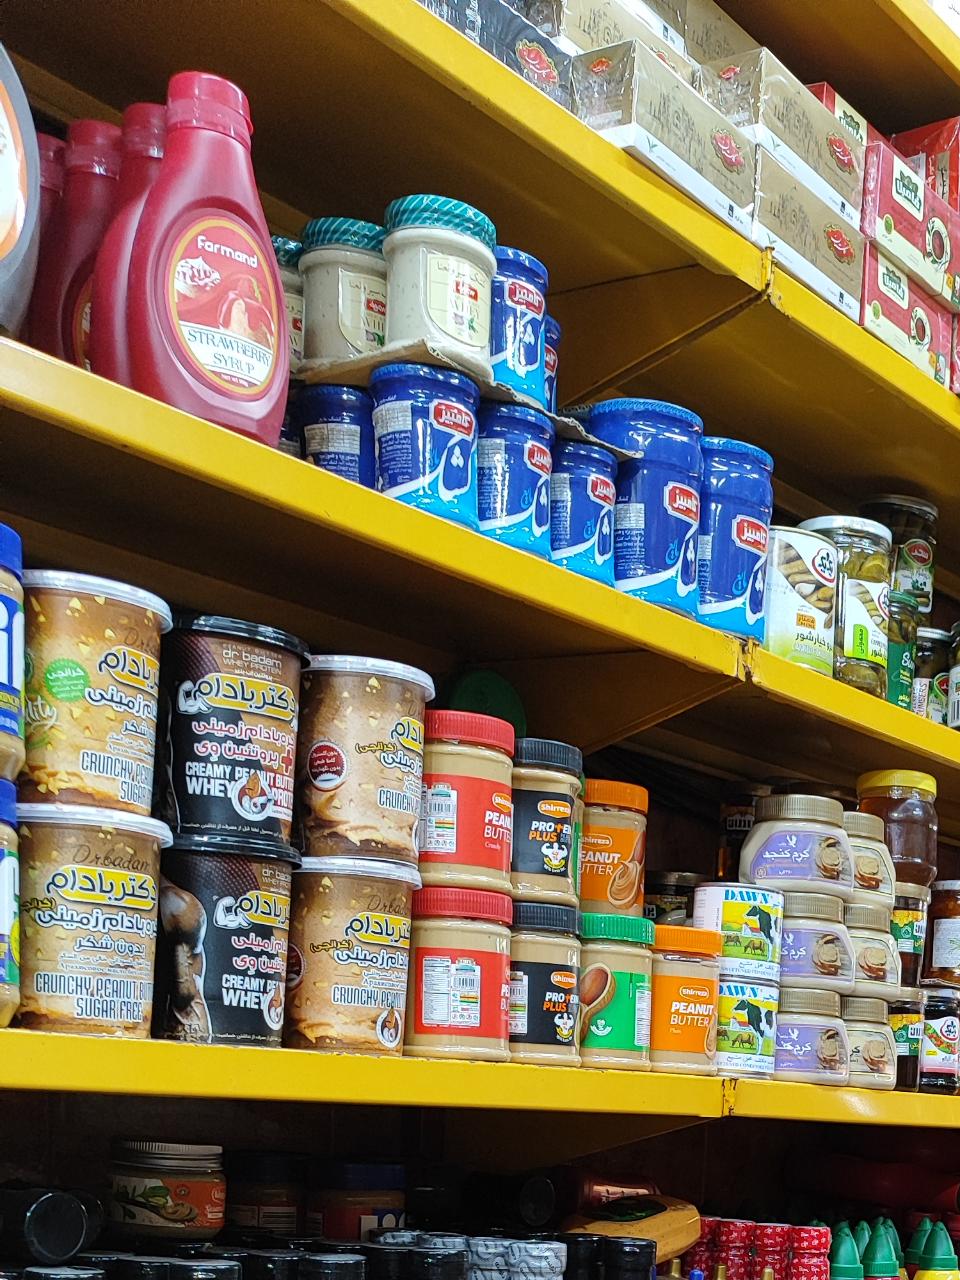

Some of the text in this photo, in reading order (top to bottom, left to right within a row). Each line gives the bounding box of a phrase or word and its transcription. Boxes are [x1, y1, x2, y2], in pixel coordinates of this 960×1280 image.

[197, 235, 258, 269] Farmand
[187, 329, 271, 368] STRAWBERRY
[213, 353, 255, 375] SYRUP
[222, 648, 282, 669] dr badam
[222, 657, 249, 668] WHEY
[81, 750, 133, 777] CRUNCHY
[185, 761, 232, 780] CREAMY
[186, 777, 235, 798] WHEY
[529, 831, 557, 843] PLUS
[724, 888, 770, 905] DAWN
[74, 934, 147, 957] بدون شکر
[35, 972, 139, 1002] CRUNCHY PEANUT
[221, 973, 265, 992] CREAMY
[222, 989, 269, 1010] WHEY
[332, 984, 380, 1007] CRUNCHY
[76, 997, 144, 1022] SUGAR FREE
[543, 1002, 567, 1013] PLUS
[671, 1001, 714, 1015] PEANUT
[670, 1014, 710, 1027] BUTTER
